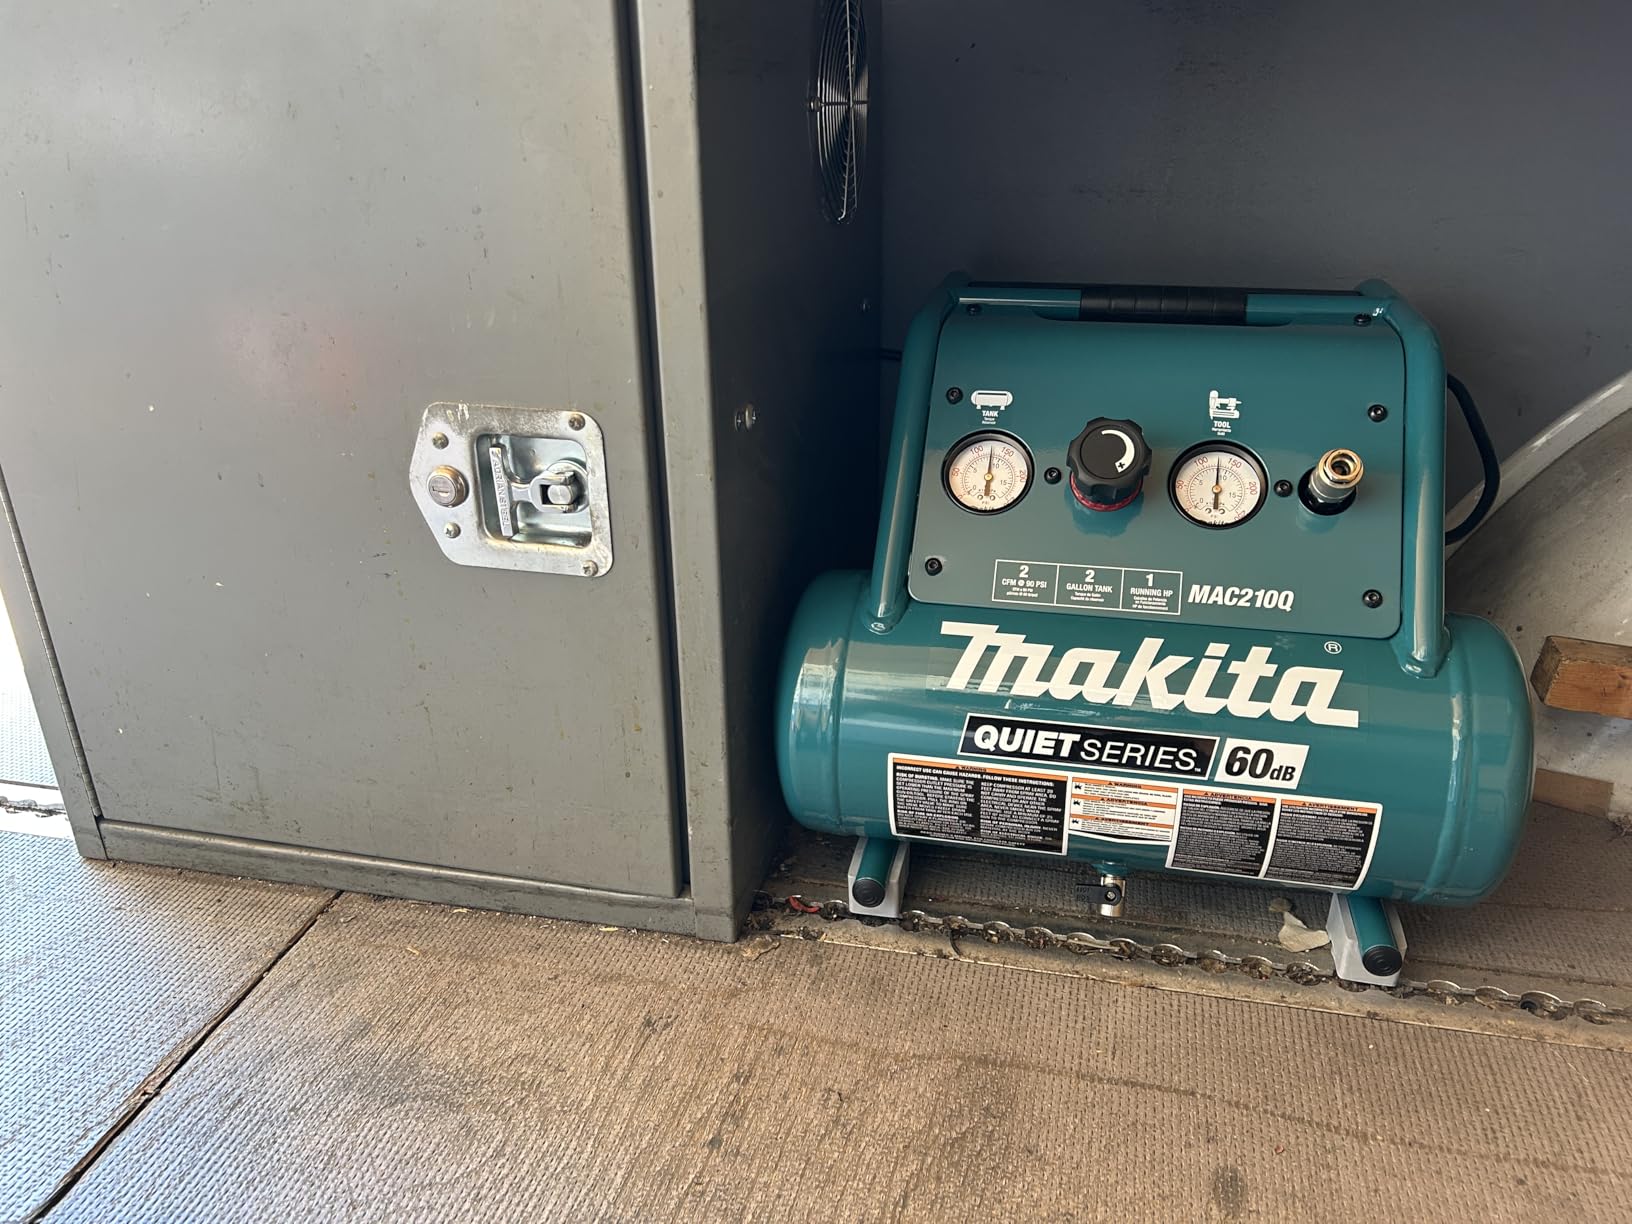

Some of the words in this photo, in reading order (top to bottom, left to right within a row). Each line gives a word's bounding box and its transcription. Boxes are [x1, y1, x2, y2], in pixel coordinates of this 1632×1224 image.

[1213, 420, 1231, 428] TOOL
[970, 445, 984, 455] 100
[1001, 446, 1014, 457] 150
[1194, 456, 1208, 467] 100
[1228, 457, 1242, 468] 150
[1249, 482, 1257, 496] 200
[1019, 565, 1029, 578] 2
[1084, 570, 1095, 582] 2
[1002, 578, 1016, 586] CFM
[1146, 574, 1154, 586] 1
[1066, 583, 1094, 592] GALLON
[1130, 588, 1162, 596] RUNNING
[1188, 584, 1294, 612] MAC210Q
[974, 724, 1081, 758] QUIET
[1225, 746, 1296, 782] 60dB
